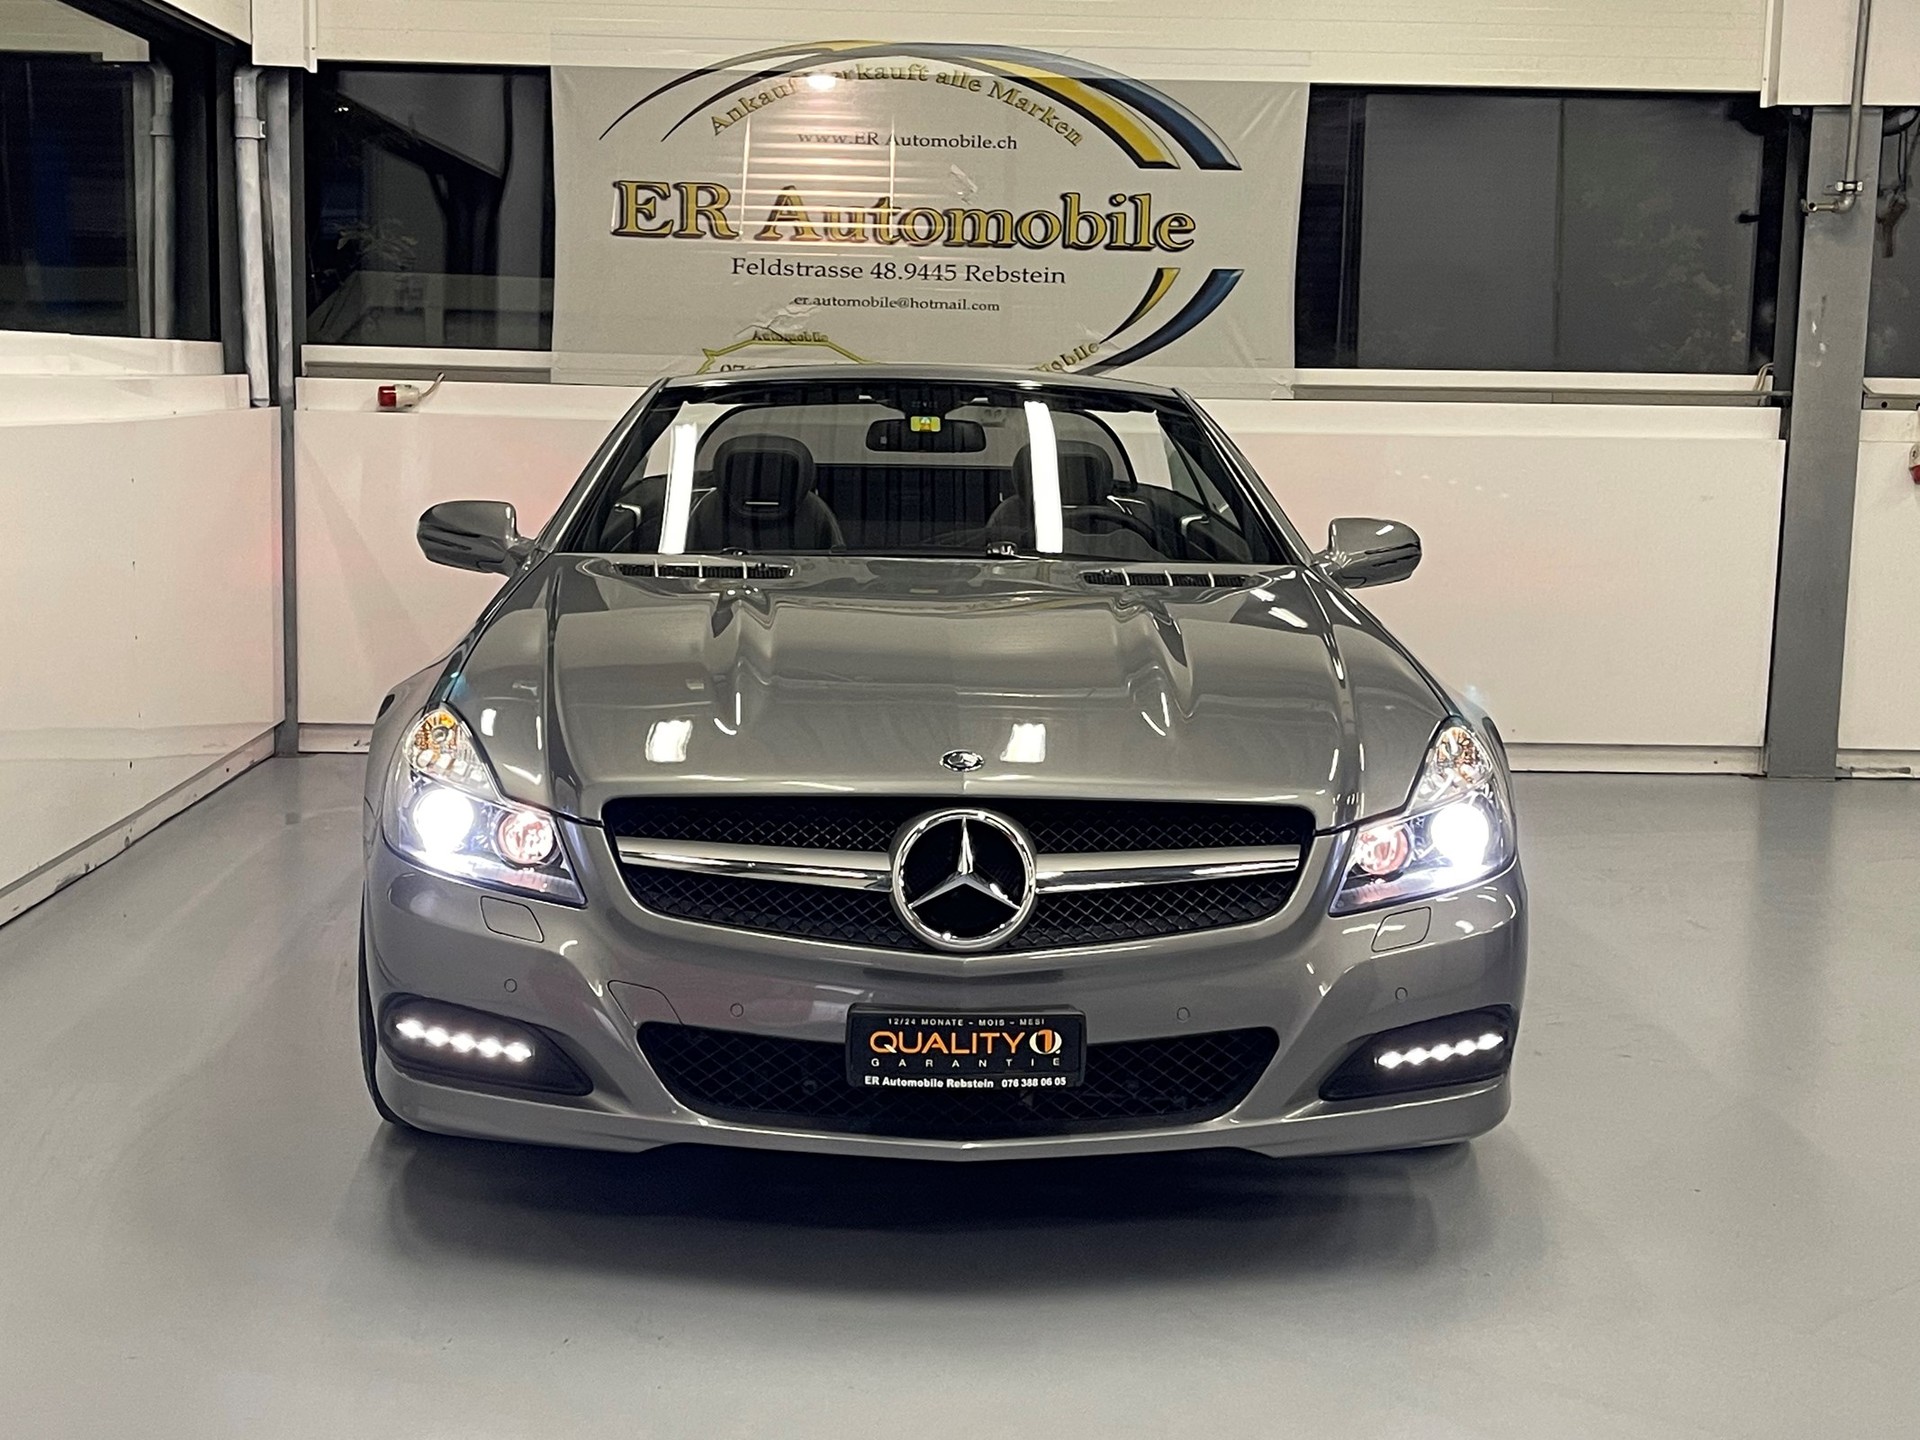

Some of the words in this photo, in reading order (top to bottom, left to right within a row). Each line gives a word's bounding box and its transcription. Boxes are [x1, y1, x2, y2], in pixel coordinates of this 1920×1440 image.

[803, 63, 929, 82] rkauft
[935, 70, 982, 92] alle
[987, 80, 1083, 147] Marken
[797, 132, 880, 146] www.ER
[885, 133, 1018, 149] Automobile.ch
[610, 180, 742, 239] ER
[753, 185, 1197, 252] Automobile
[730, 257, 864, 279] Feldstrasse
[869, 262, 957, 281] 48.9445
[964, 264, 1066, 284] Rebstein
[793, 296, 1000, 311] er.automobile@hotmail.com
[888, 1018, 916, 1026] 12/24
[921, 1018, 963, 1026] MONATE
[978, 1019, 1005, 1027] MOIS
[869, 1030, 1026, 1054] QUALITY
[870, 1057, 1060, 1068] GARANTIE
[864, 1075, 880, 1086] ER
[882, 1076, 944, 1088] Automobile
[946, 1078, 994, 1089] Rebstein
[1040, 1077, 1053, 1087] 06
[1054, 1076, 1067, 1086] 05
